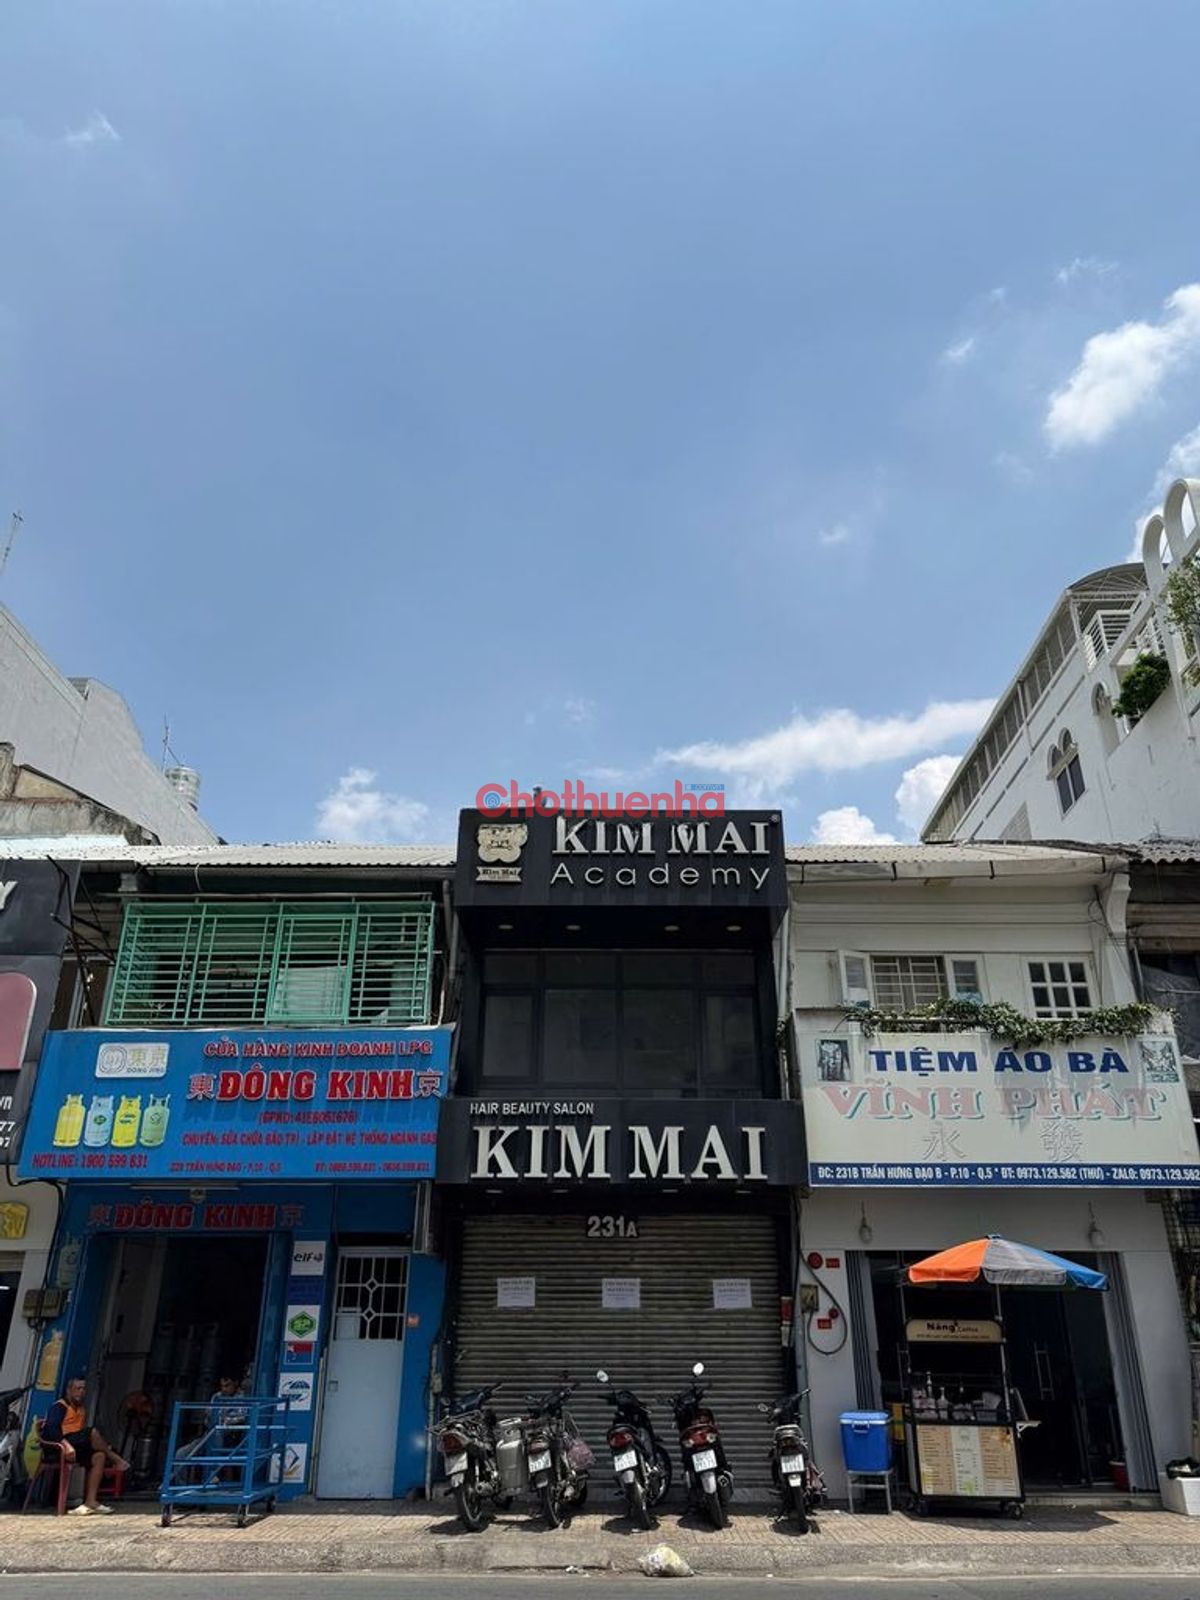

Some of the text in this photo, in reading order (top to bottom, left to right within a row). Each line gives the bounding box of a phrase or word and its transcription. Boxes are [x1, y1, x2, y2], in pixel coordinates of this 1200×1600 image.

[552, 815, 770, 854] KIM MAI
[551, 862, 770, 890] Academy
[294, 1042, 334, 1056] KINH
[869, 1046, 1129, 1076] TIỆM ÁO BÀ
[216, 1062, 317, 1101] ĐÔNG
[326, 1068, 415, 1100] KINH
[414, 1067, 443, 1098] 京
[470, 1102, 594, 1115] HAIR BEAUTY SALON
[819, 1078, 1167, 1120] VĨNH PHÁT
[470, 1125, 768, 1180] KIM MAI
[950, 1167, 969, 1179] P.10
[204, 1204, 277, 1229] KINH
[587, 1215, 638, 1237] 231A
